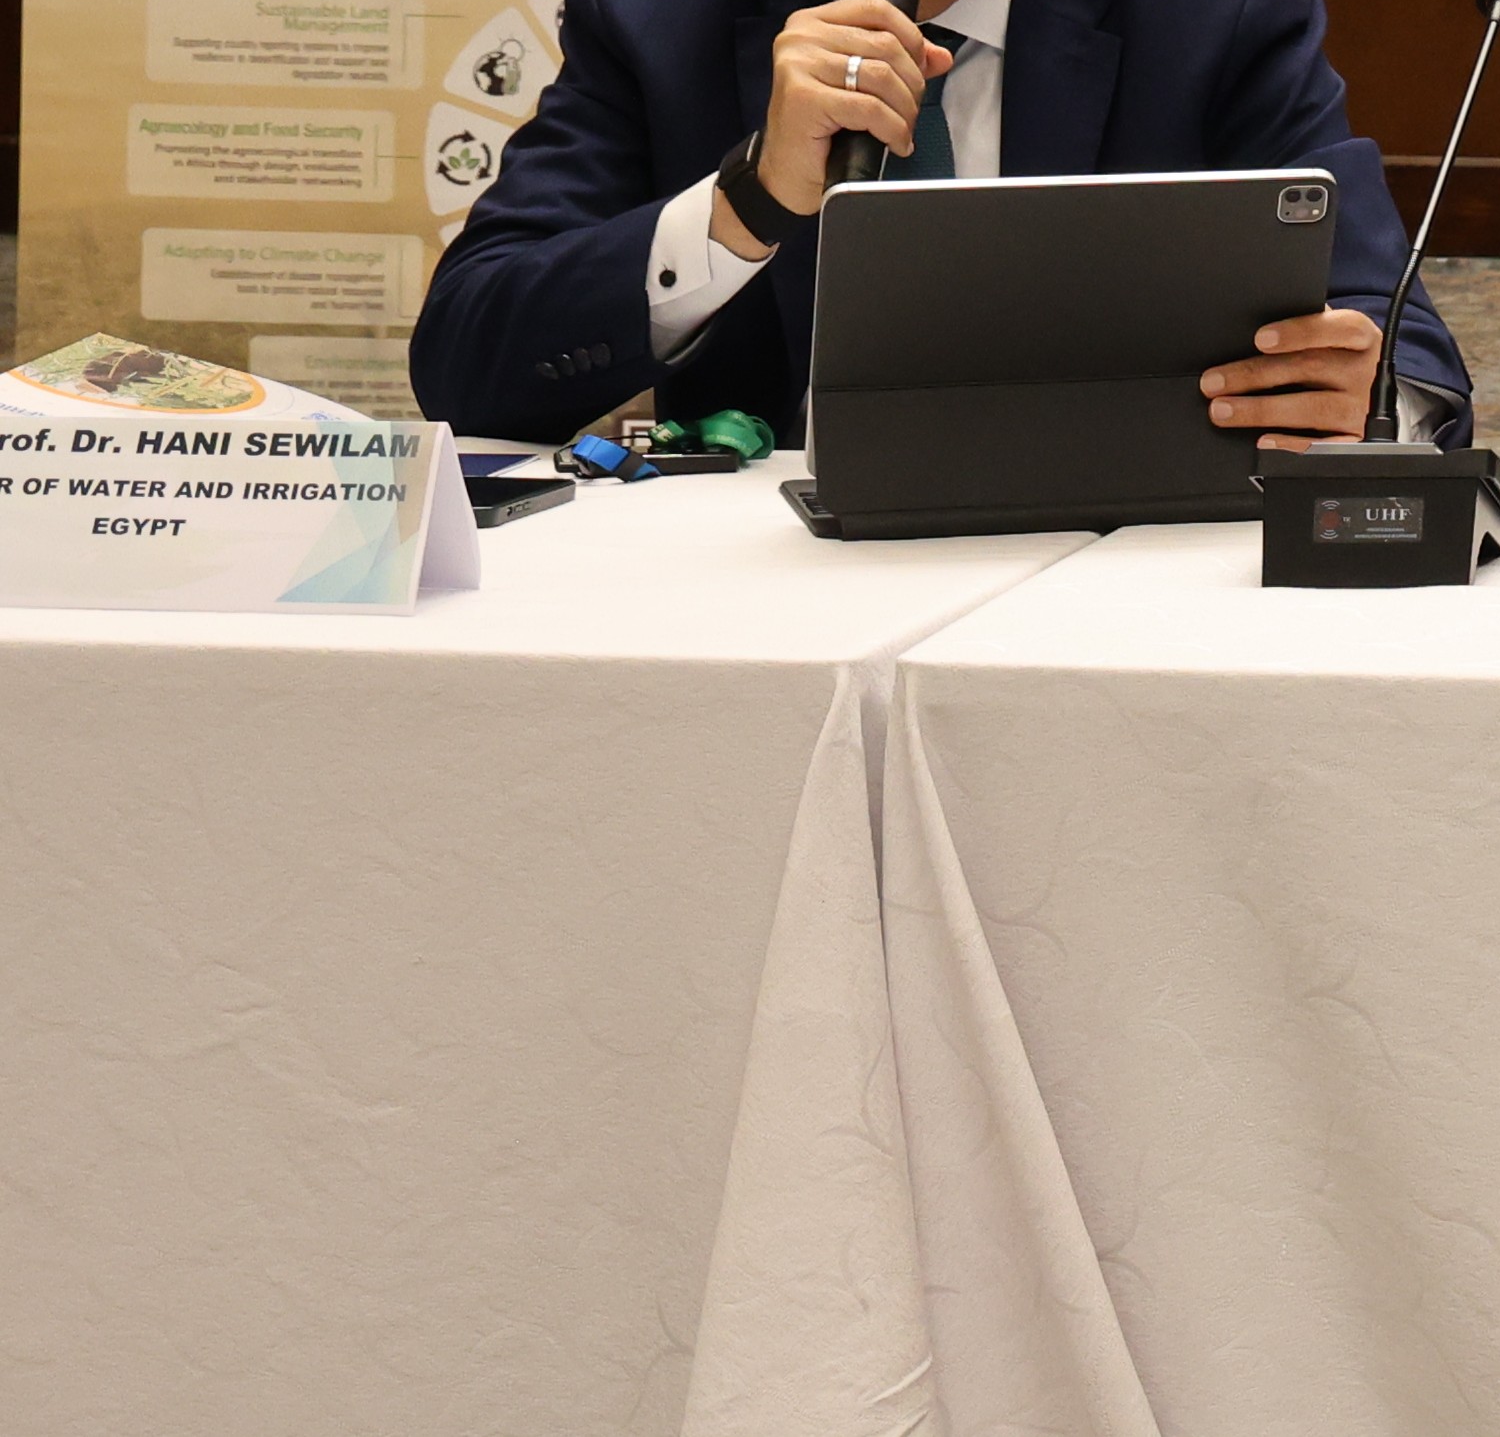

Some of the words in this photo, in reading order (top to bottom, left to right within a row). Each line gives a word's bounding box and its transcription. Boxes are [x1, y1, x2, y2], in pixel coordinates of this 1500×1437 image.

[0, 428, 55, 452] rof.
[71, 430, 121, 453] Dr.
[136, 431, 231, 455] HANI
[244, 433, 419, 458] SEWILAM
[23, 478, 59, 495] OF
[69, 479, 166, 497] WATER
[175, 481, 233, 499] AND
[243, 483, 407, 502] IRRIGATION
[1366, 508, 1409, 520] UHF
[92, 517, 186, 536] EGYPT
